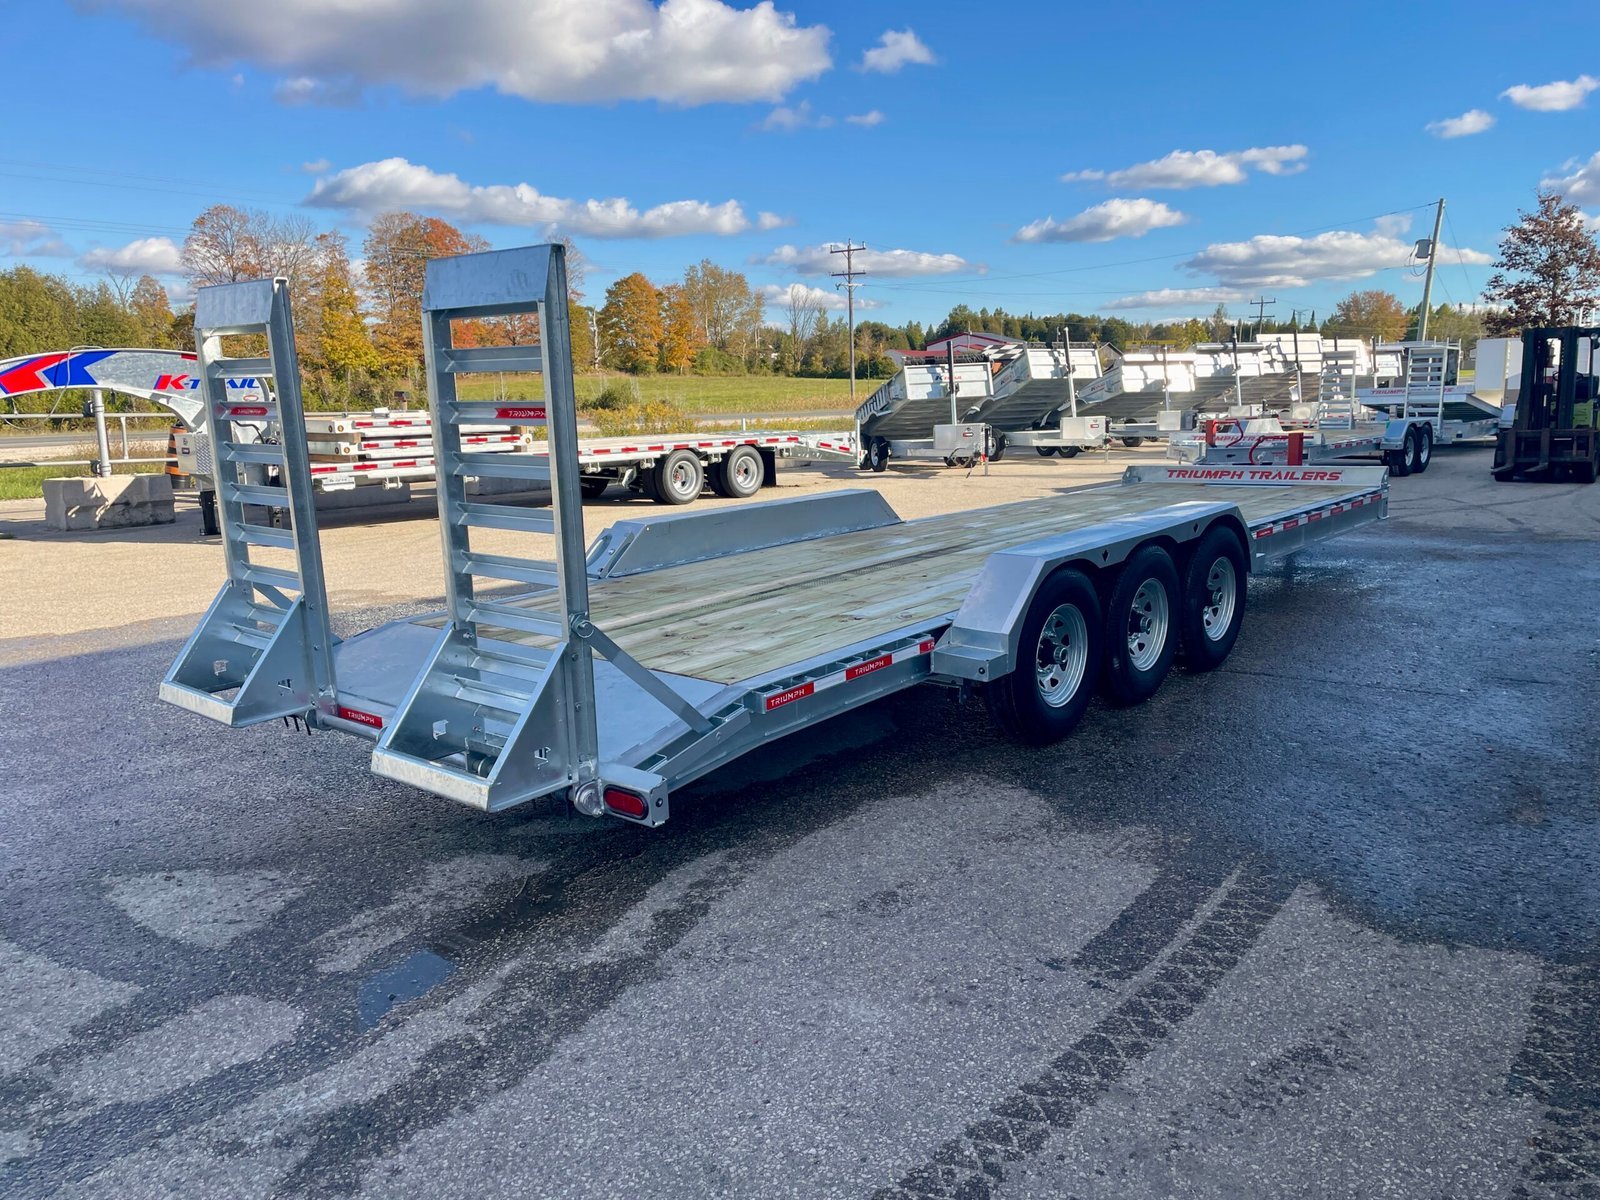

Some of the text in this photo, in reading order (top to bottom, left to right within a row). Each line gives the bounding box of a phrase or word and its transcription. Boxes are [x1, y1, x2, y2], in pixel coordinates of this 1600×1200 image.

[1167, 469, 1343, 481] TRIUMPH TRAILERS
[854, 660, 885, 676] TRIUMPH
[770, 688, 806, 707] TRIUMPH
[347, 711, 375, 724] TRIUMPH
